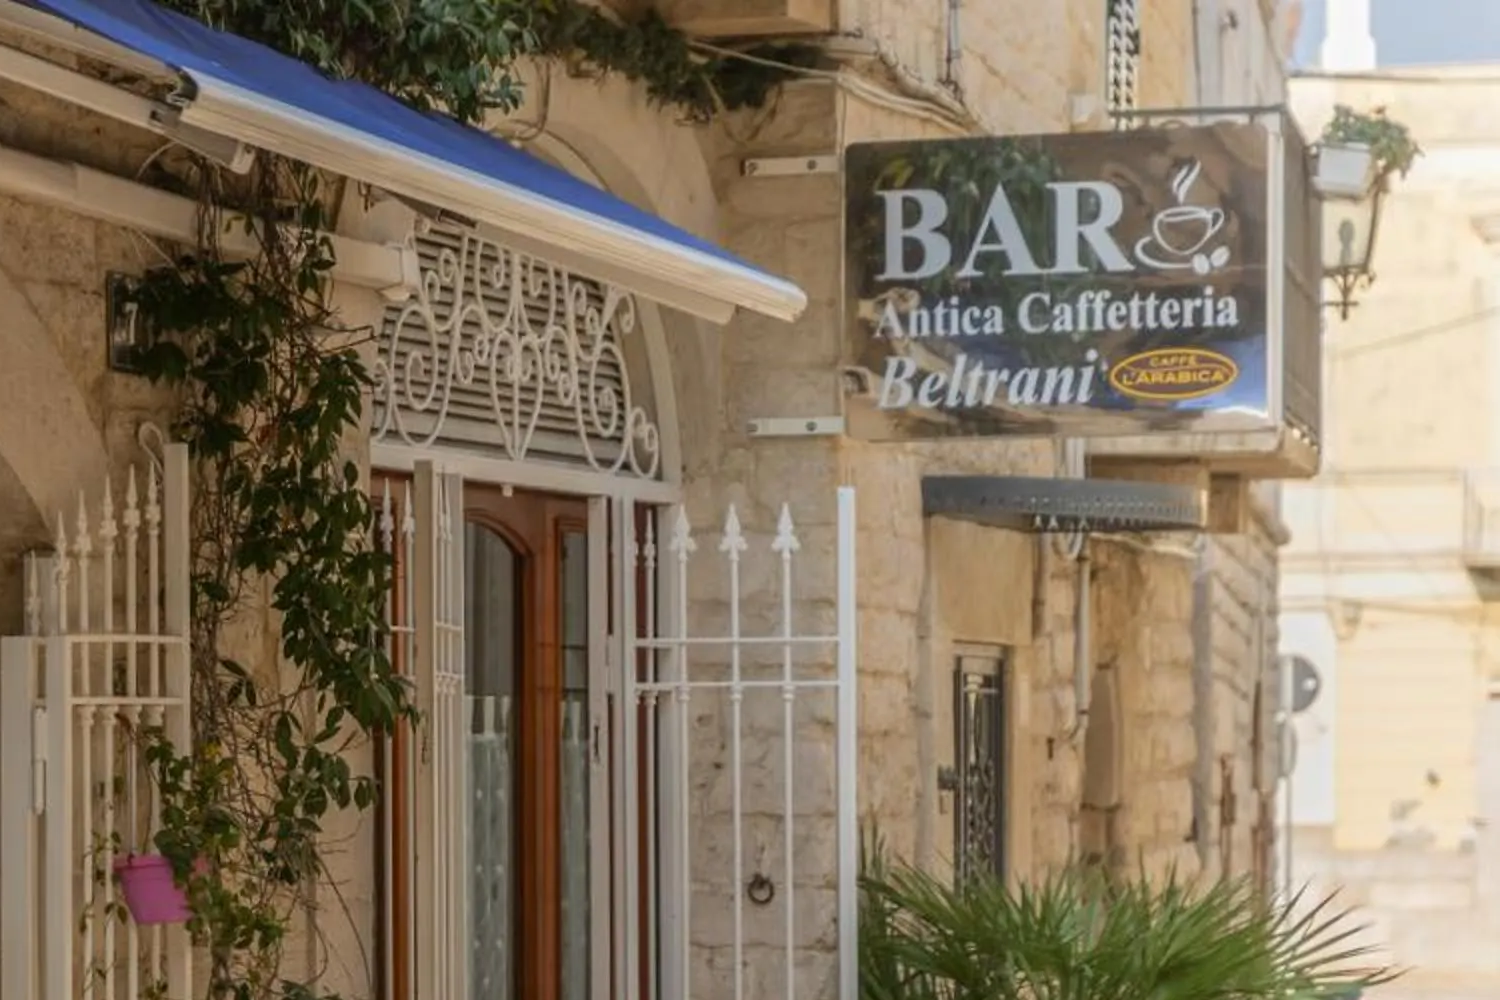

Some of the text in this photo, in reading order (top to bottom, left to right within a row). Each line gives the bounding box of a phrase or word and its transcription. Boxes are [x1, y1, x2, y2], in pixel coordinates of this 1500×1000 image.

[873, 180, 1137, 282] BAR
[873, 285, 1240, 339] Antica Caffetteria
[878, 349, 1099, 410] Beltrani
[1122, 369, 1225, 386] L'ARABICA
